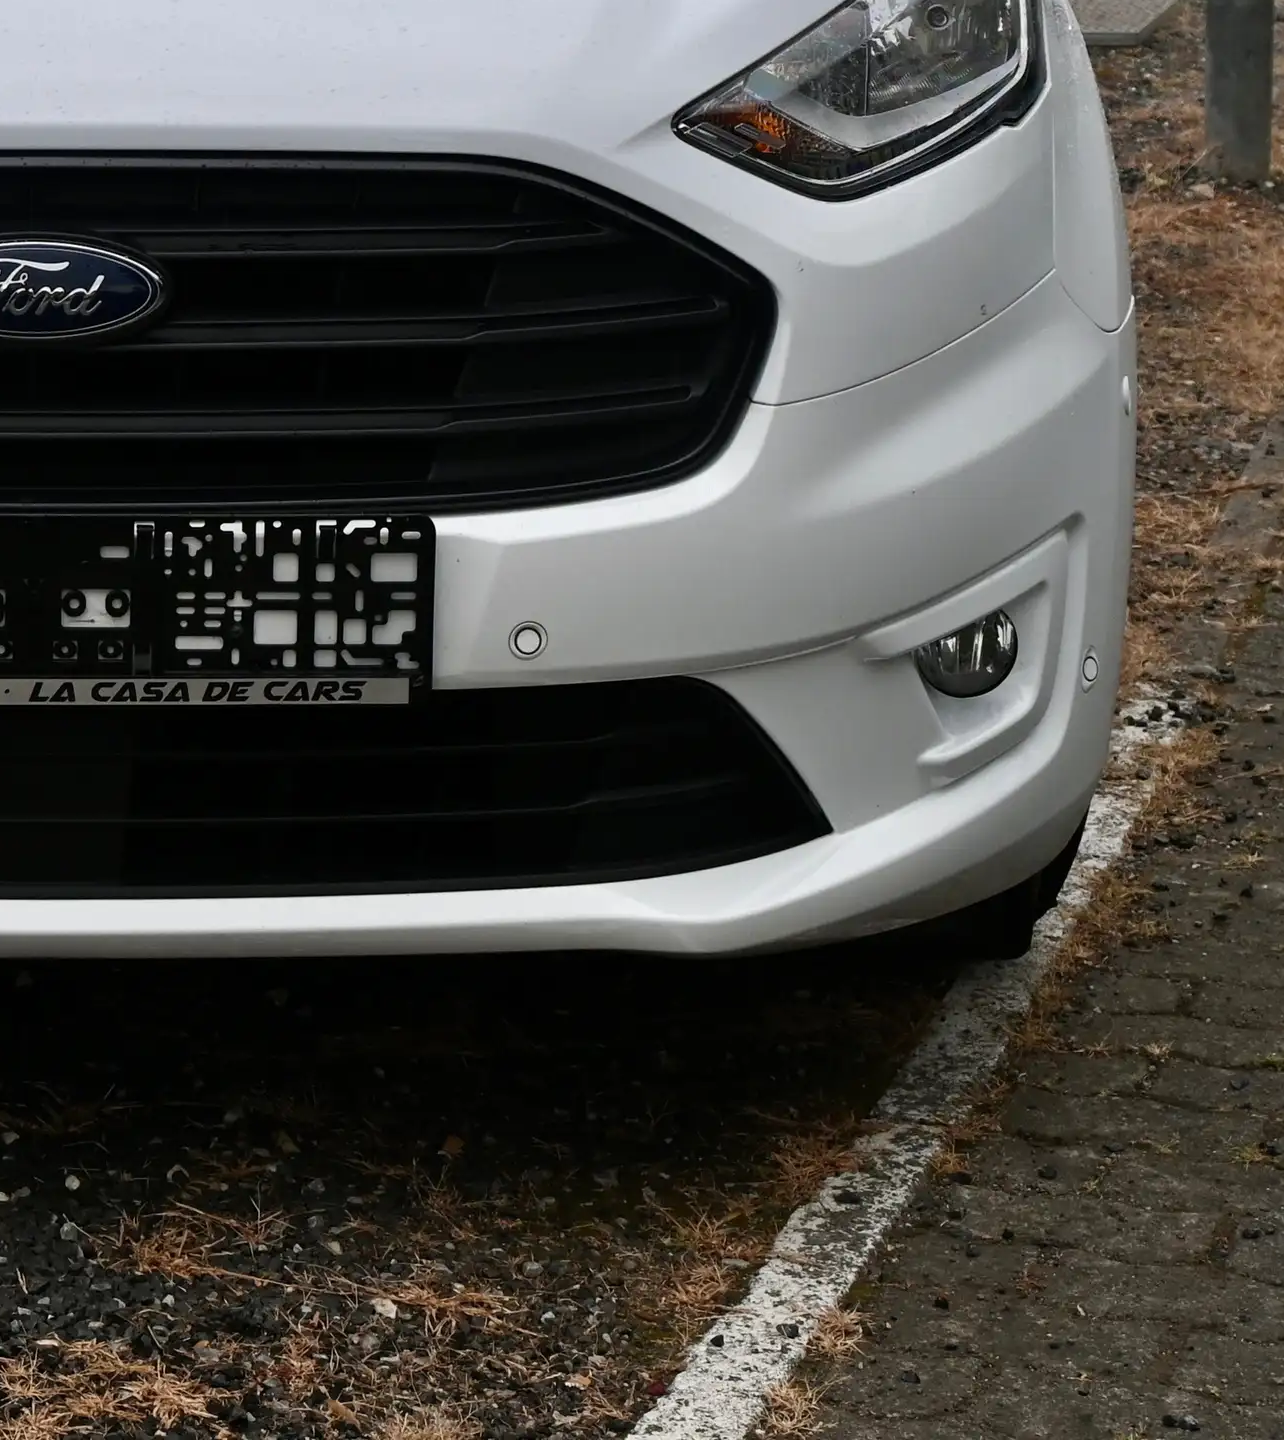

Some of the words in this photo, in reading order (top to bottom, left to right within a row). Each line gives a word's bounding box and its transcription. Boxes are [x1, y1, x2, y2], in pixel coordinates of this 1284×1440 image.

[28, 681, 77, 703] LA
[90, 681, 191, 703] CASA
[200, 681, 255, 702] DE
[262, 680, 368, 702] CARS
